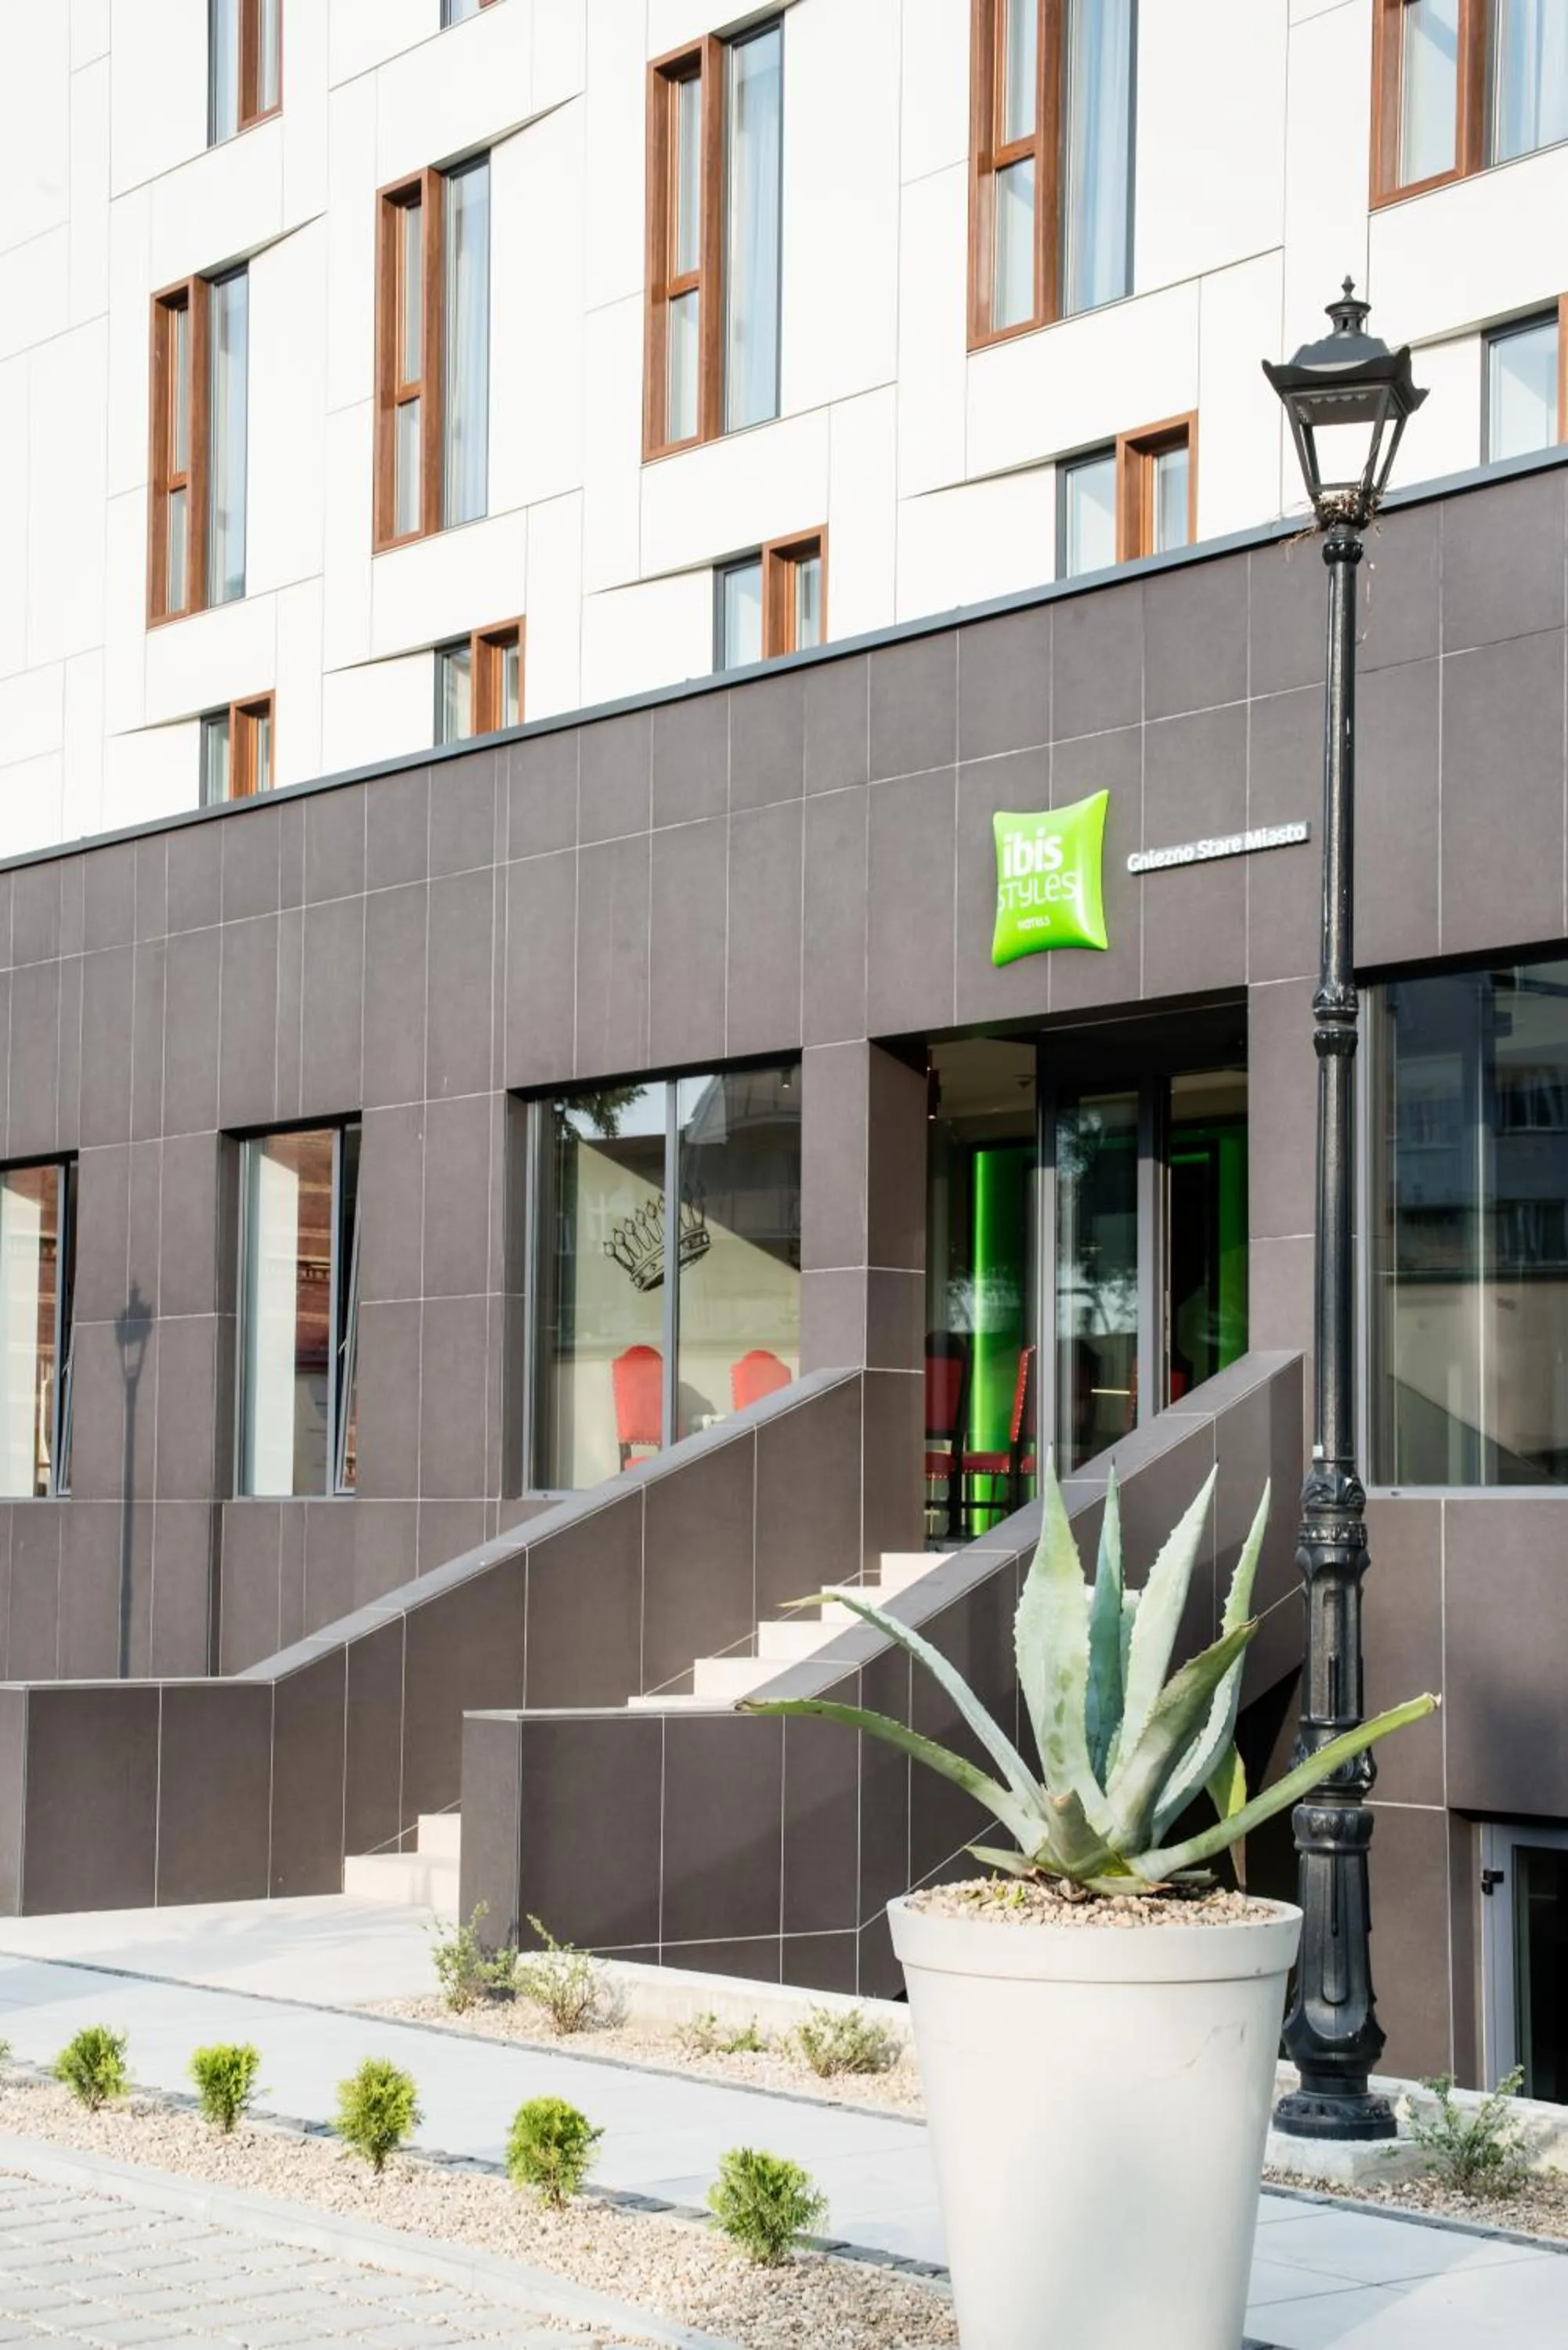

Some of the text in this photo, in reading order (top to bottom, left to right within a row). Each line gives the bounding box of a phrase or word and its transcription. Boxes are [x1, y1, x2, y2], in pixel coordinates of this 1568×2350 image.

[1003, 826, 1063, 878] ibis
[1128, 822, 1306, 873] Gniezno Stare Miasto
